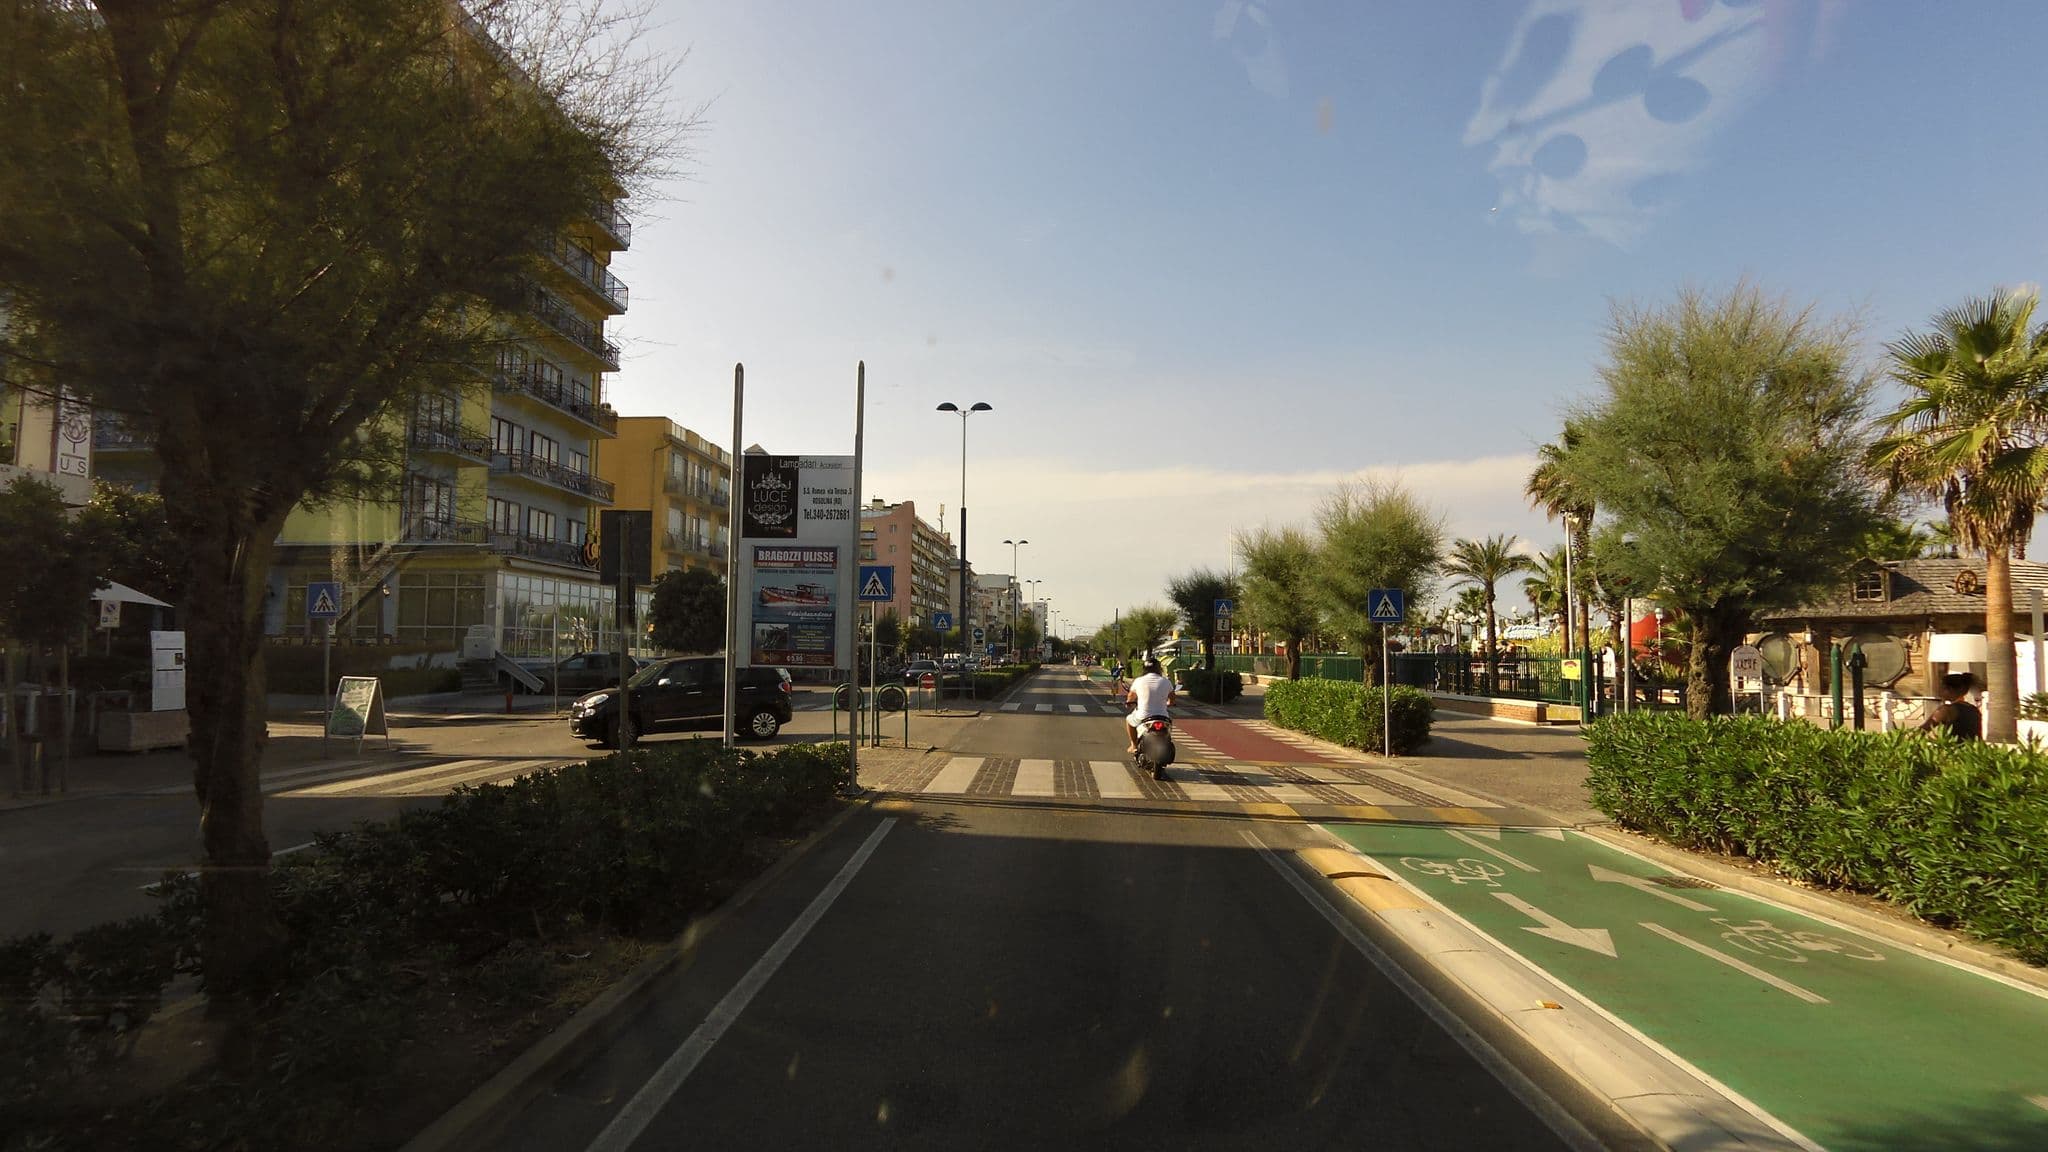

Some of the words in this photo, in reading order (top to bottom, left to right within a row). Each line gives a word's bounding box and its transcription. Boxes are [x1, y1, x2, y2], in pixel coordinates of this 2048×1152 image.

[779, 458, 817, 471] Lampadari
[753, 490, 788, 503] LUCE
[753, 502, 787, 514] design
[758, 550, 801, 562] BRAGOZZI
[803, 551, 834, 563] ULISSE
